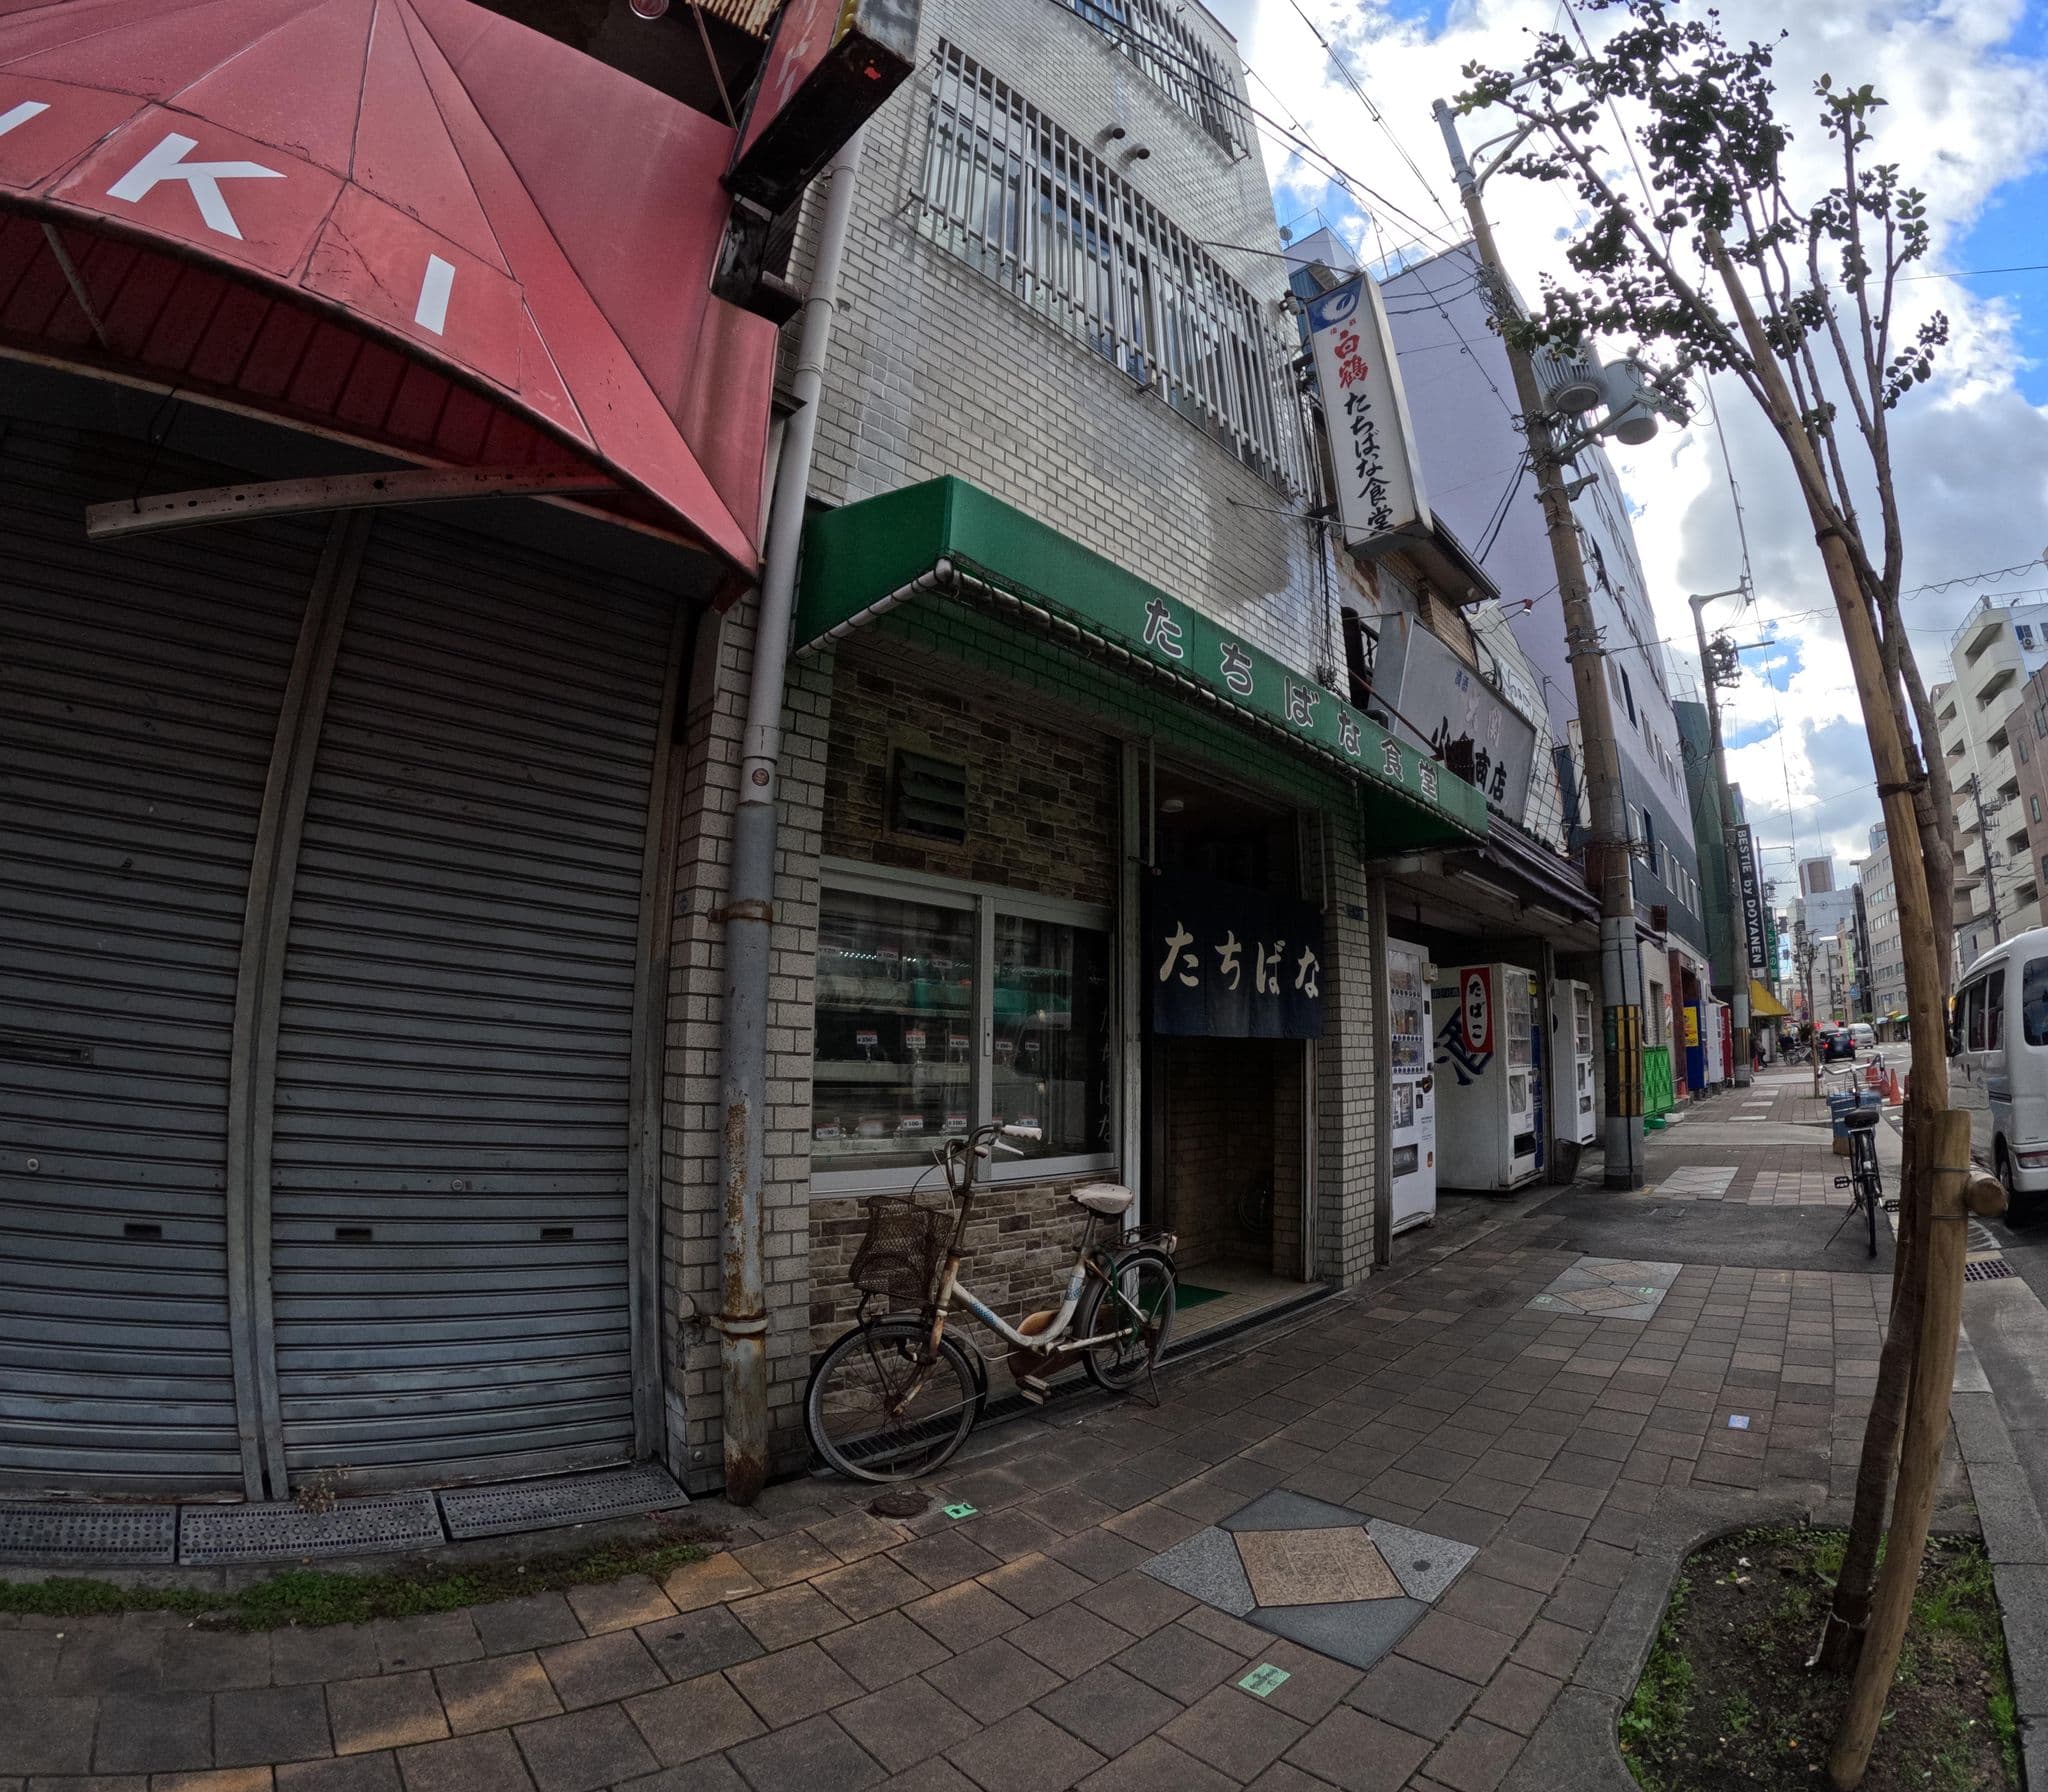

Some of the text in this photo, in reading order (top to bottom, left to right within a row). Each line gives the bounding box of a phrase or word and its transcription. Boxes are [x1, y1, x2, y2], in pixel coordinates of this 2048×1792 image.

[1334, 330, 1369, 390] 白鶴
[1343, 391, 1395, 538] たちばな食堂
[1142, 597, 1440, 802] たちばな食堂
[1737, 829, 1752, 873] BESTIE
[1742, 879, 1754, 896] by
[1159, 920, 1320, 999] たちばな
[1746, 899, 1762, 964] DOYANEN
[1469, 980, 1485, 1039] たばこ
